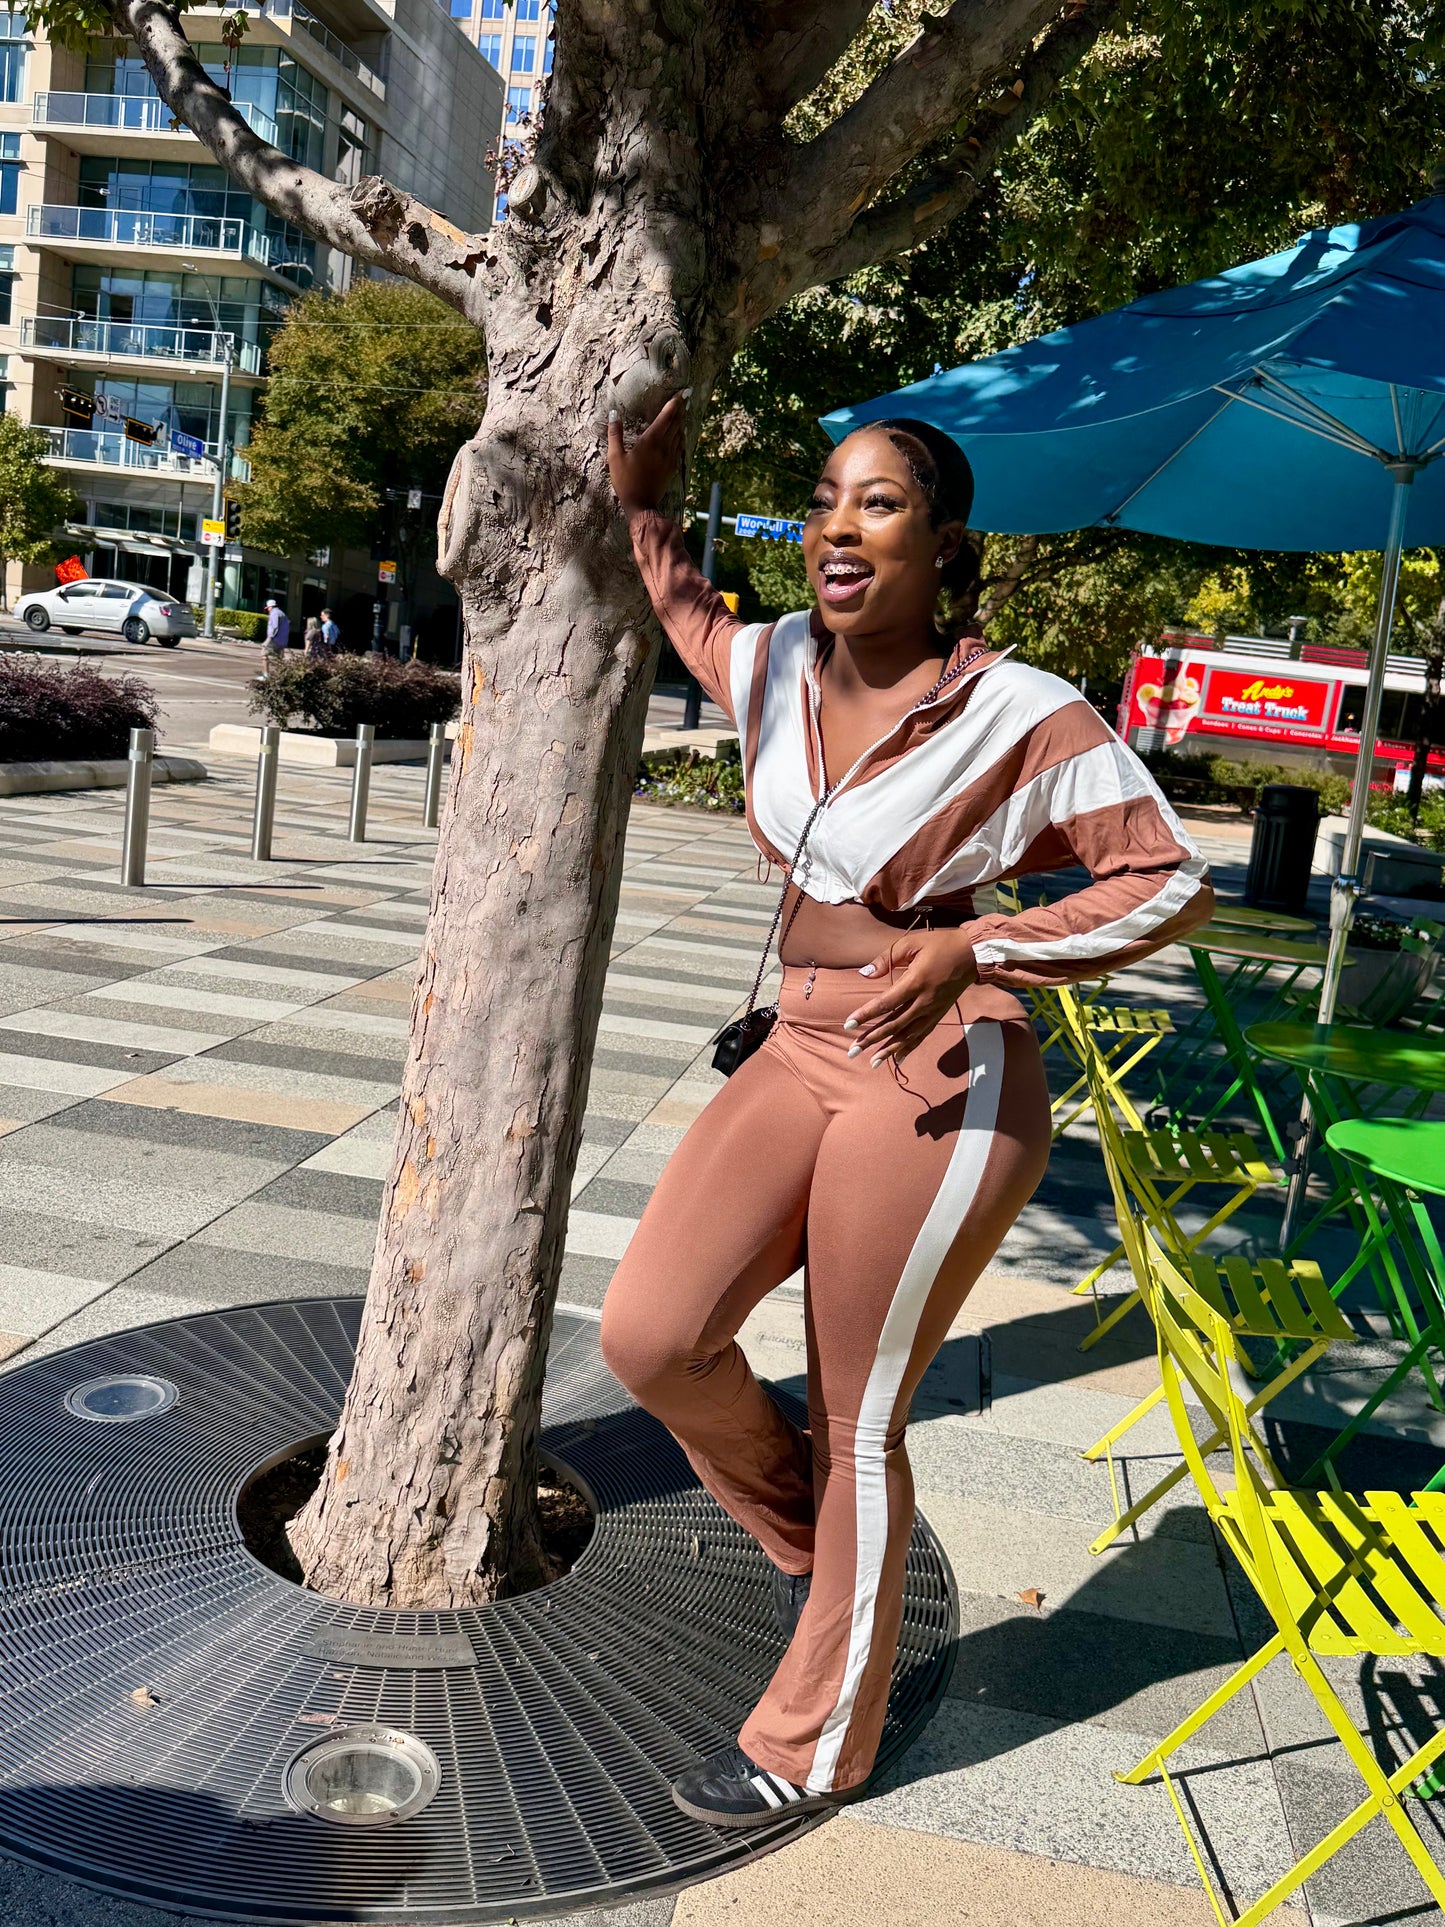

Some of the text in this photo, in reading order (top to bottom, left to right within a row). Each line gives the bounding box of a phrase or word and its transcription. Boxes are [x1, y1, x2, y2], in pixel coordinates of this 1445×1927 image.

[177, 434, 197, 451] Olive
[1241, 680, 1294, 701] Andy's
[1221, 696, 1309, 721] Treat Truck
[1237, 723, 1257, 732] Cones
[1265, 726, 1281, 735] Cups
